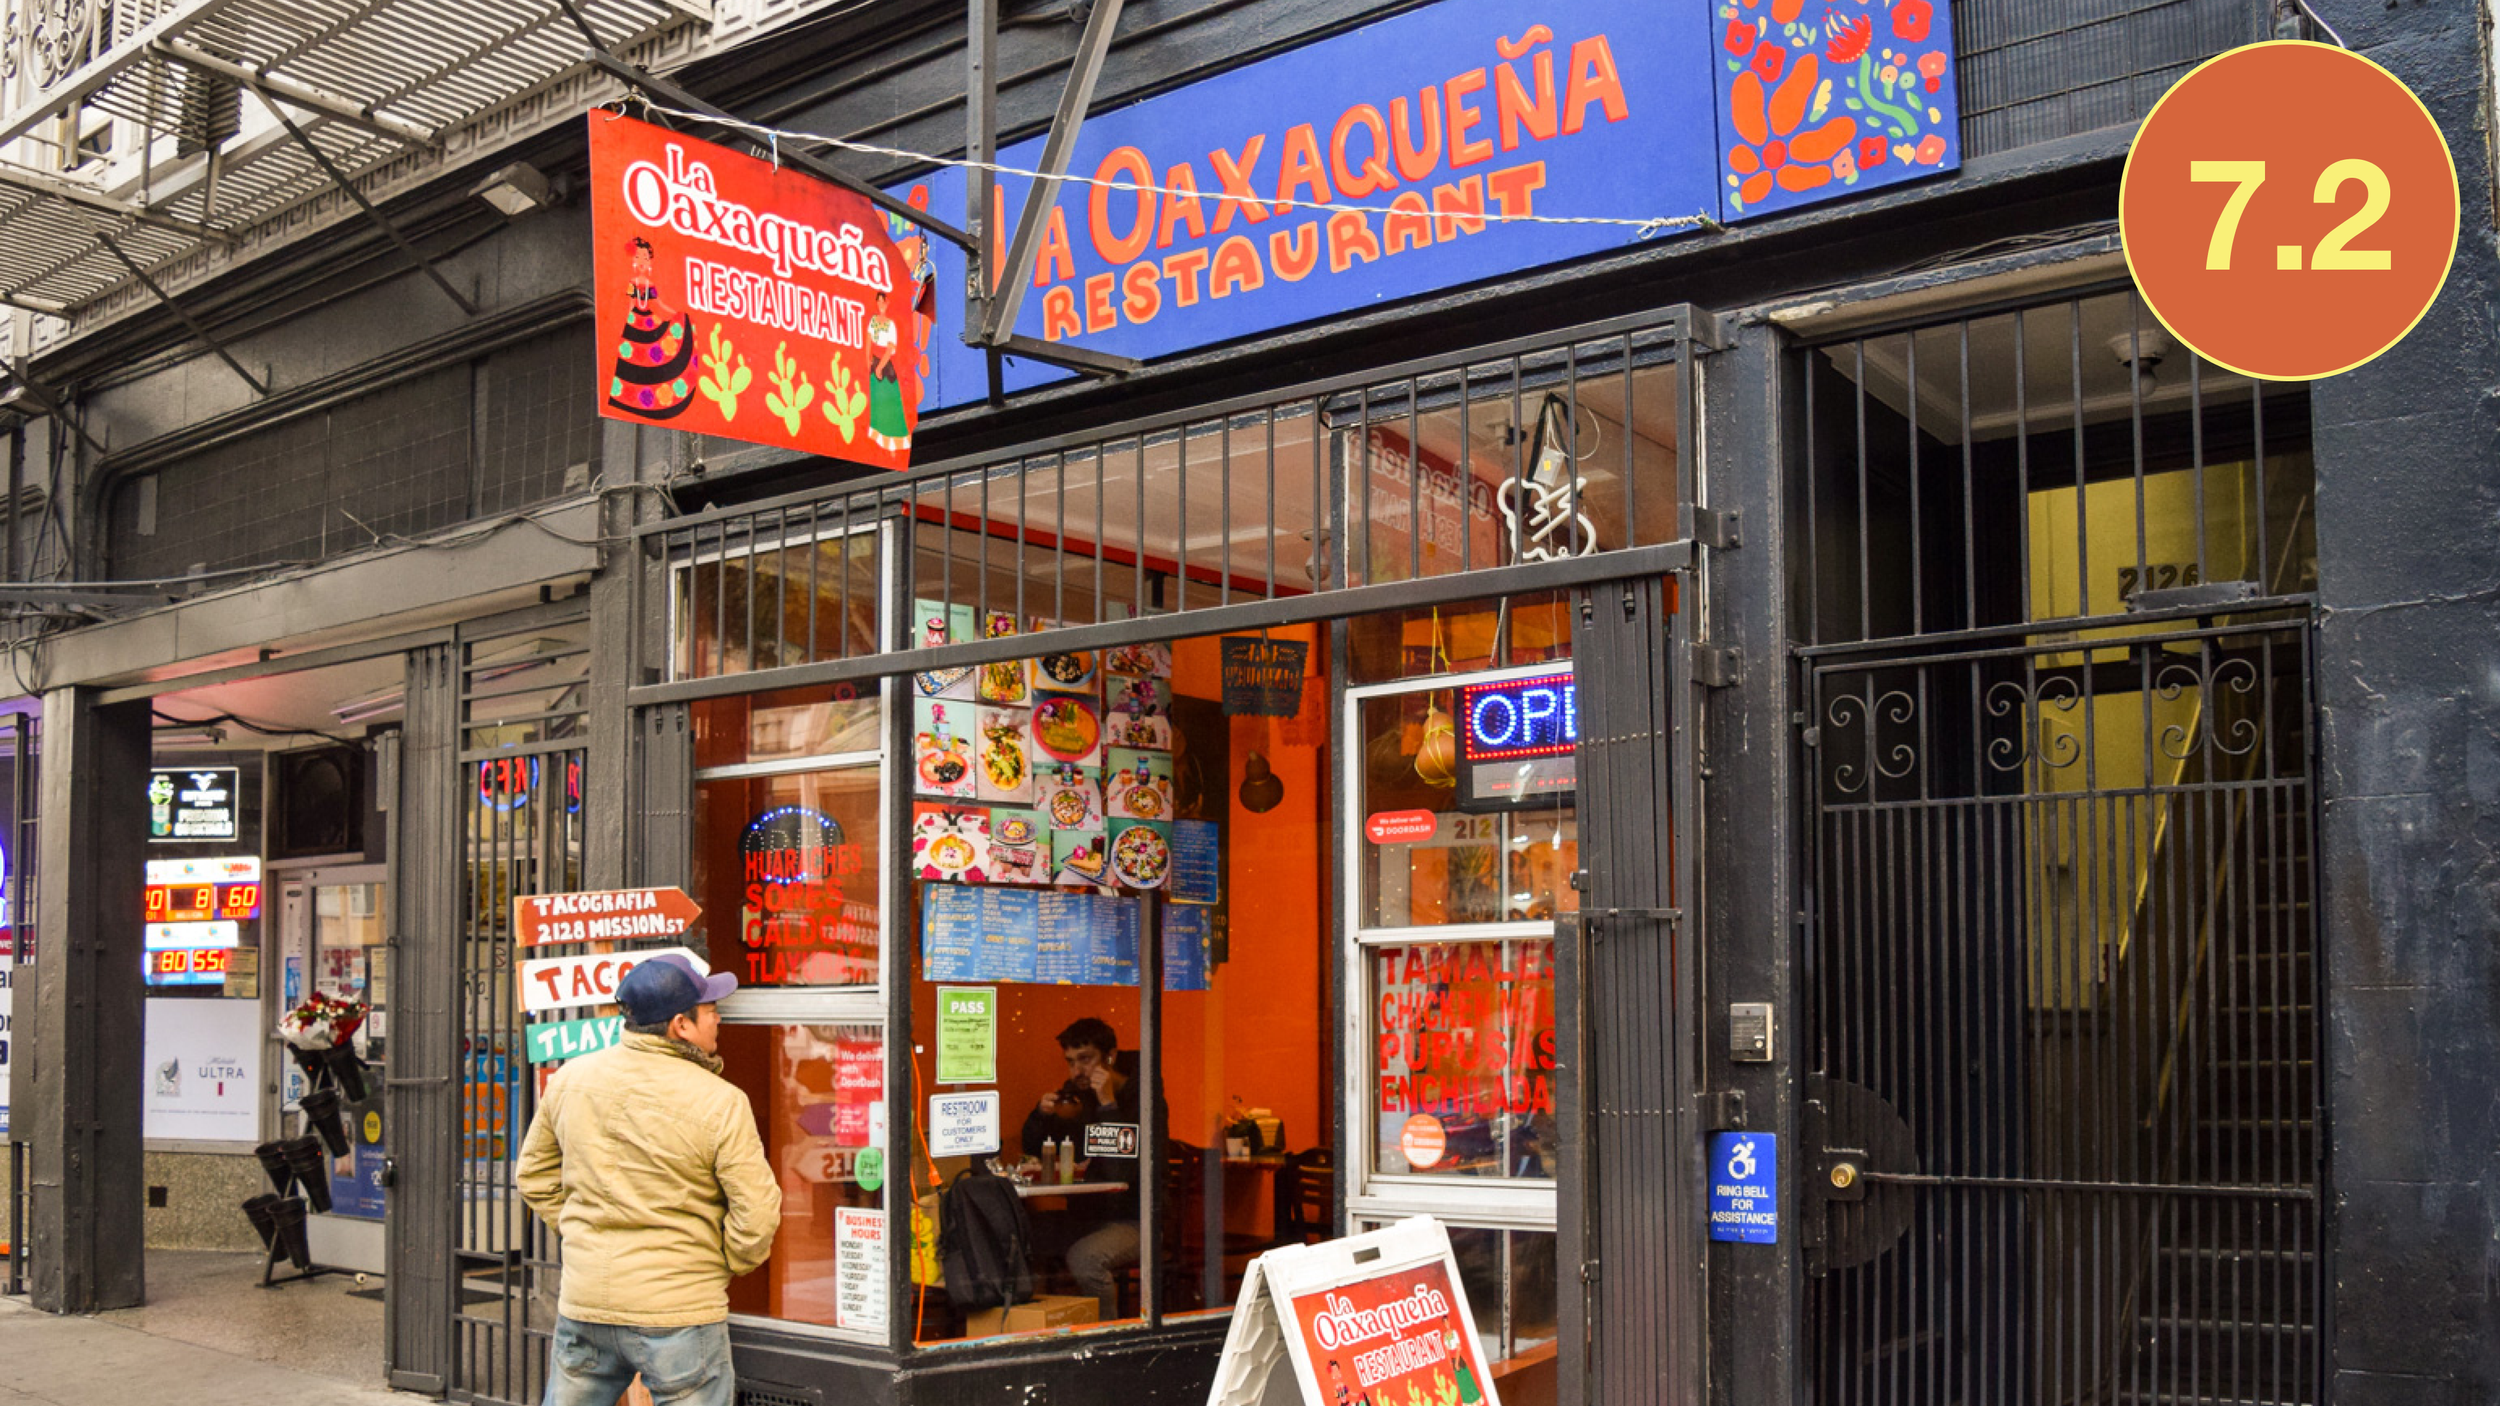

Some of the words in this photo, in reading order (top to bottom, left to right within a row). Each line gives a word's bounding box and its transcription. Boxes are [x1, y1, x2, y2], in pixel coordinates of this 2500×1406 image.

[1089, 24, 1629, 266] OAXAQUEÑA
[666, 143, 717, 195] La
[622, 160, 894, 293] Oaxaqueña
[1042, 160, 1546, 342] RESTAURANT
[685, 256, 866, 350] RESTAURANT
[1386, 825, 1431, 835] DOORDASH
[745, 843, 863, 882] HUARACHES
[195, 887, 210, 908] 8
[228, 886, 257, 908] 60
[533, 891, 658, 917] TACOGRAFIA
[746, 877, 844, 914] SOPES
[538, 919, 585, 943] 2128
[588, 913, 666, 939] MISSION
[666, 918, 685, 934] ST
[746, 913, 857, 948] CALDOS
[160, 950, 188, 972] 80
[950, 1000, 985, 1014] PASS
[1381, 989, 1492, 1030] CHICKEN
[536, 1016, 625, 1058] TLAY
[1380, 1029, 1556, 1072] PUPUSAS
[199, 1067, 245, 1079] ULTRA
[841, 1064, 859, 1075] with
[841, 1076, 881, 1088] DoorDash
[1381, 1074, 1556, 1115] ENCHILADA
[941, 1100, 987, 1116] RESTROOM
[942, 1126, 987, 1136] CUSTOMERS
[957, 1118, 972, 1126] FOR
[1090, 1126, 1119, 1138] SORRY
[955, 1136, 973, 1144] ONLY
[1716, 1184, 1741, 1197] RING
[1743, 1186, 1769, 1198] BELL
[1731, 1198, 1754, 1211] FOR
[1711, 1210, 1775, 1226] ASSISTANCE
[851, 1228, 882, 1240] HOURS
[841, 1241, 863, 1250] MONDAY
[841, 1250, 863, 1260] TUESDAY
[841, 1261, 872, 1271] WEDNESDAY
[1325, 1292, 1356, 1318] La
[1313, 1283, 1450, 1351] Oaxaqueña
[1353, 1330, 1446, 1388] RESTAURANT
